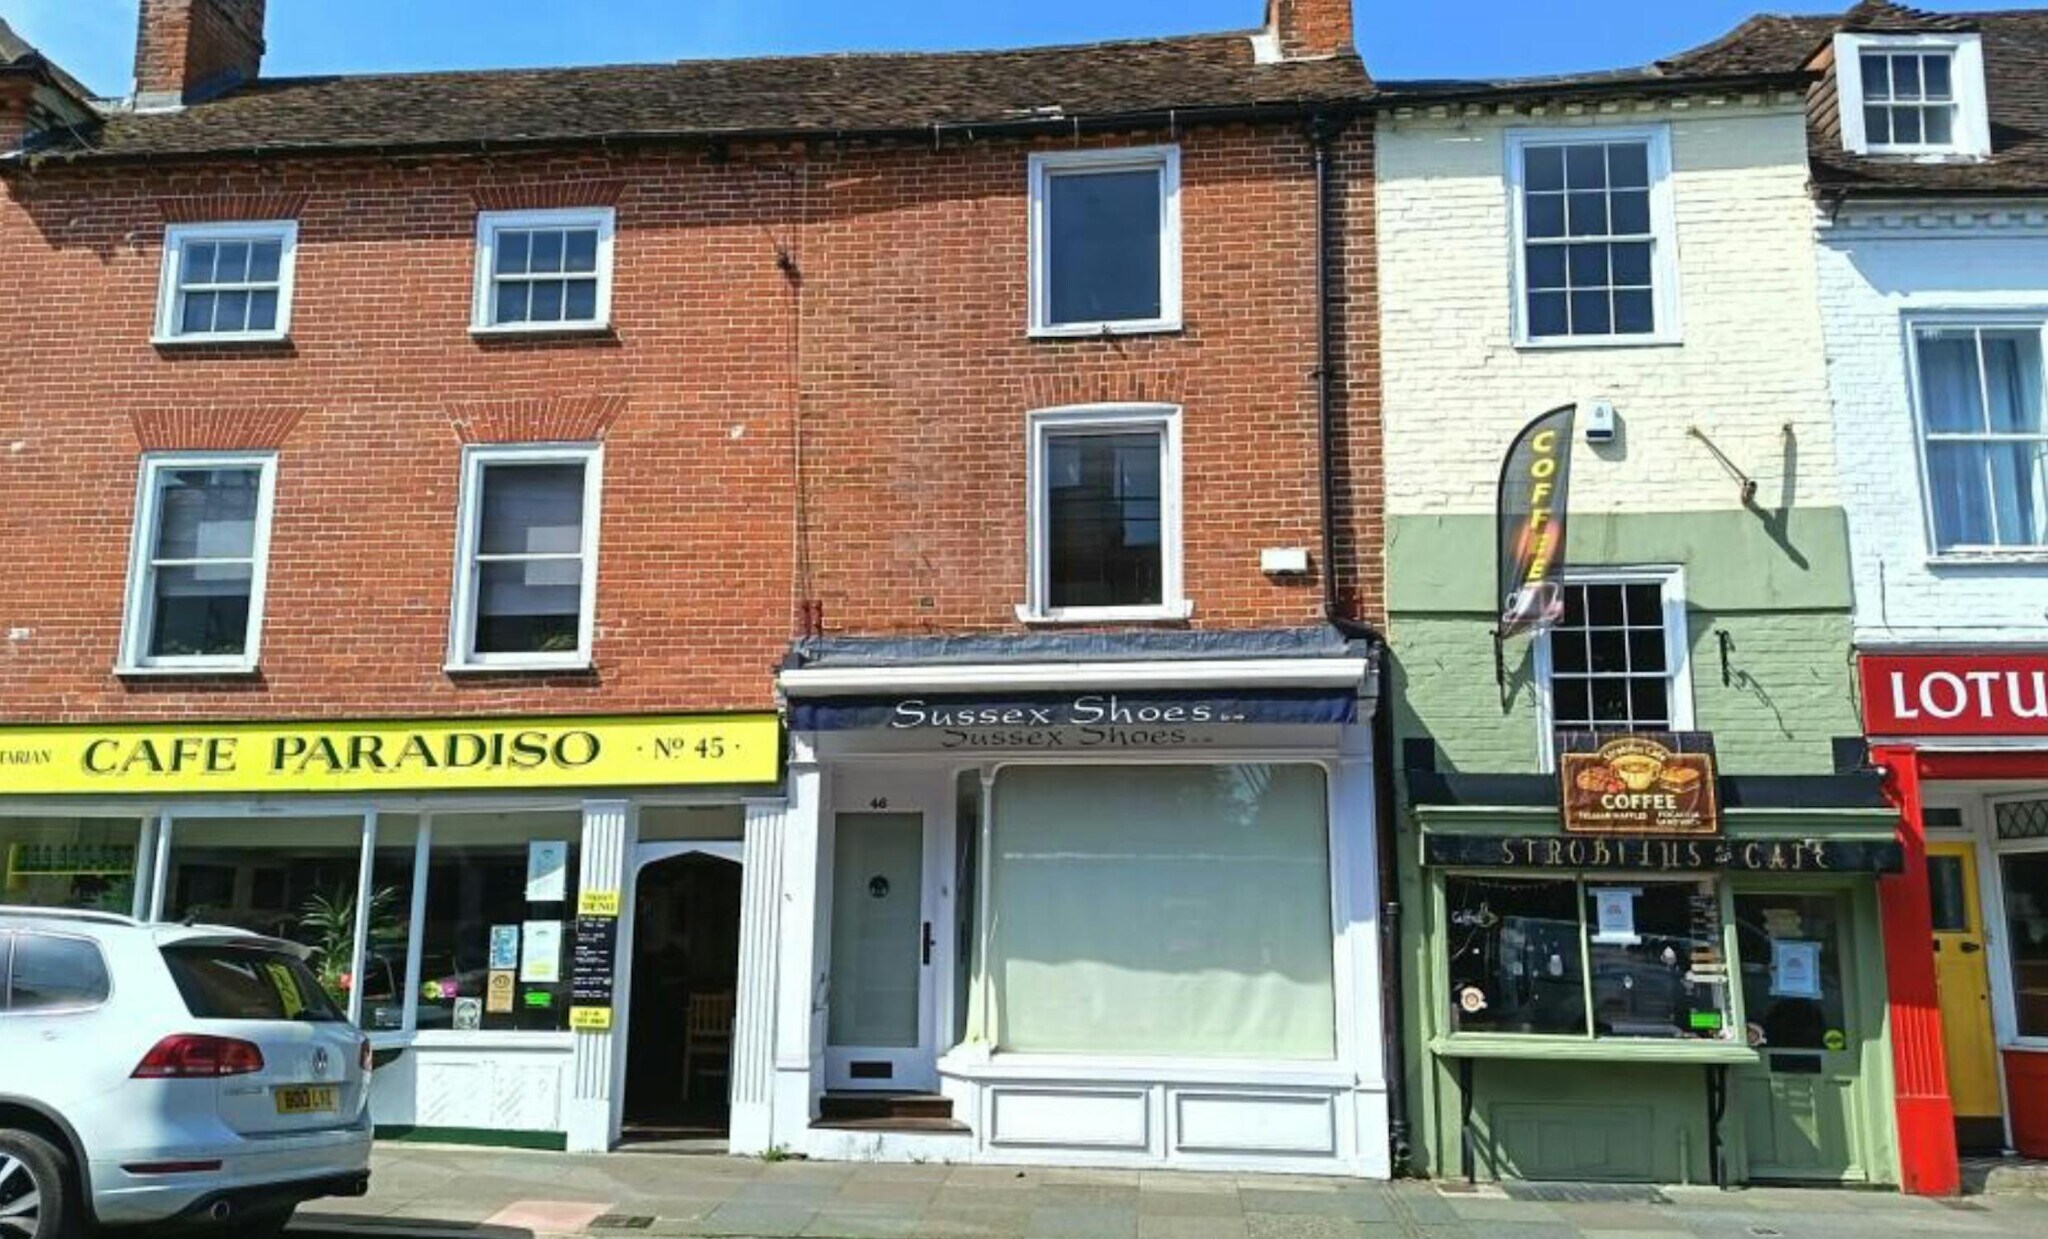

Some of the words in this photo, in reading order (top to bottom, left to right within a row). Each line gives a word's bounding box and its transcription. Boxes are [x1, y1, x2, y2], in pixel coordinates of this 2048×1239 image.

[1530, 430, 1556, 582] COFFEE
[891, 699, 1051, 728] Sussex
[1069, 695, 1212, 724] Shoes
[1890, 670, 2048, 719] LOTU
[81, 737, 239, 775] CAFE
[267, 730, 601, 774] PARADISO
[694, 737, 724, 758] 45
[870, 797, 887, 809] 46
[1601, 793, 1677, 810] COFFEE
